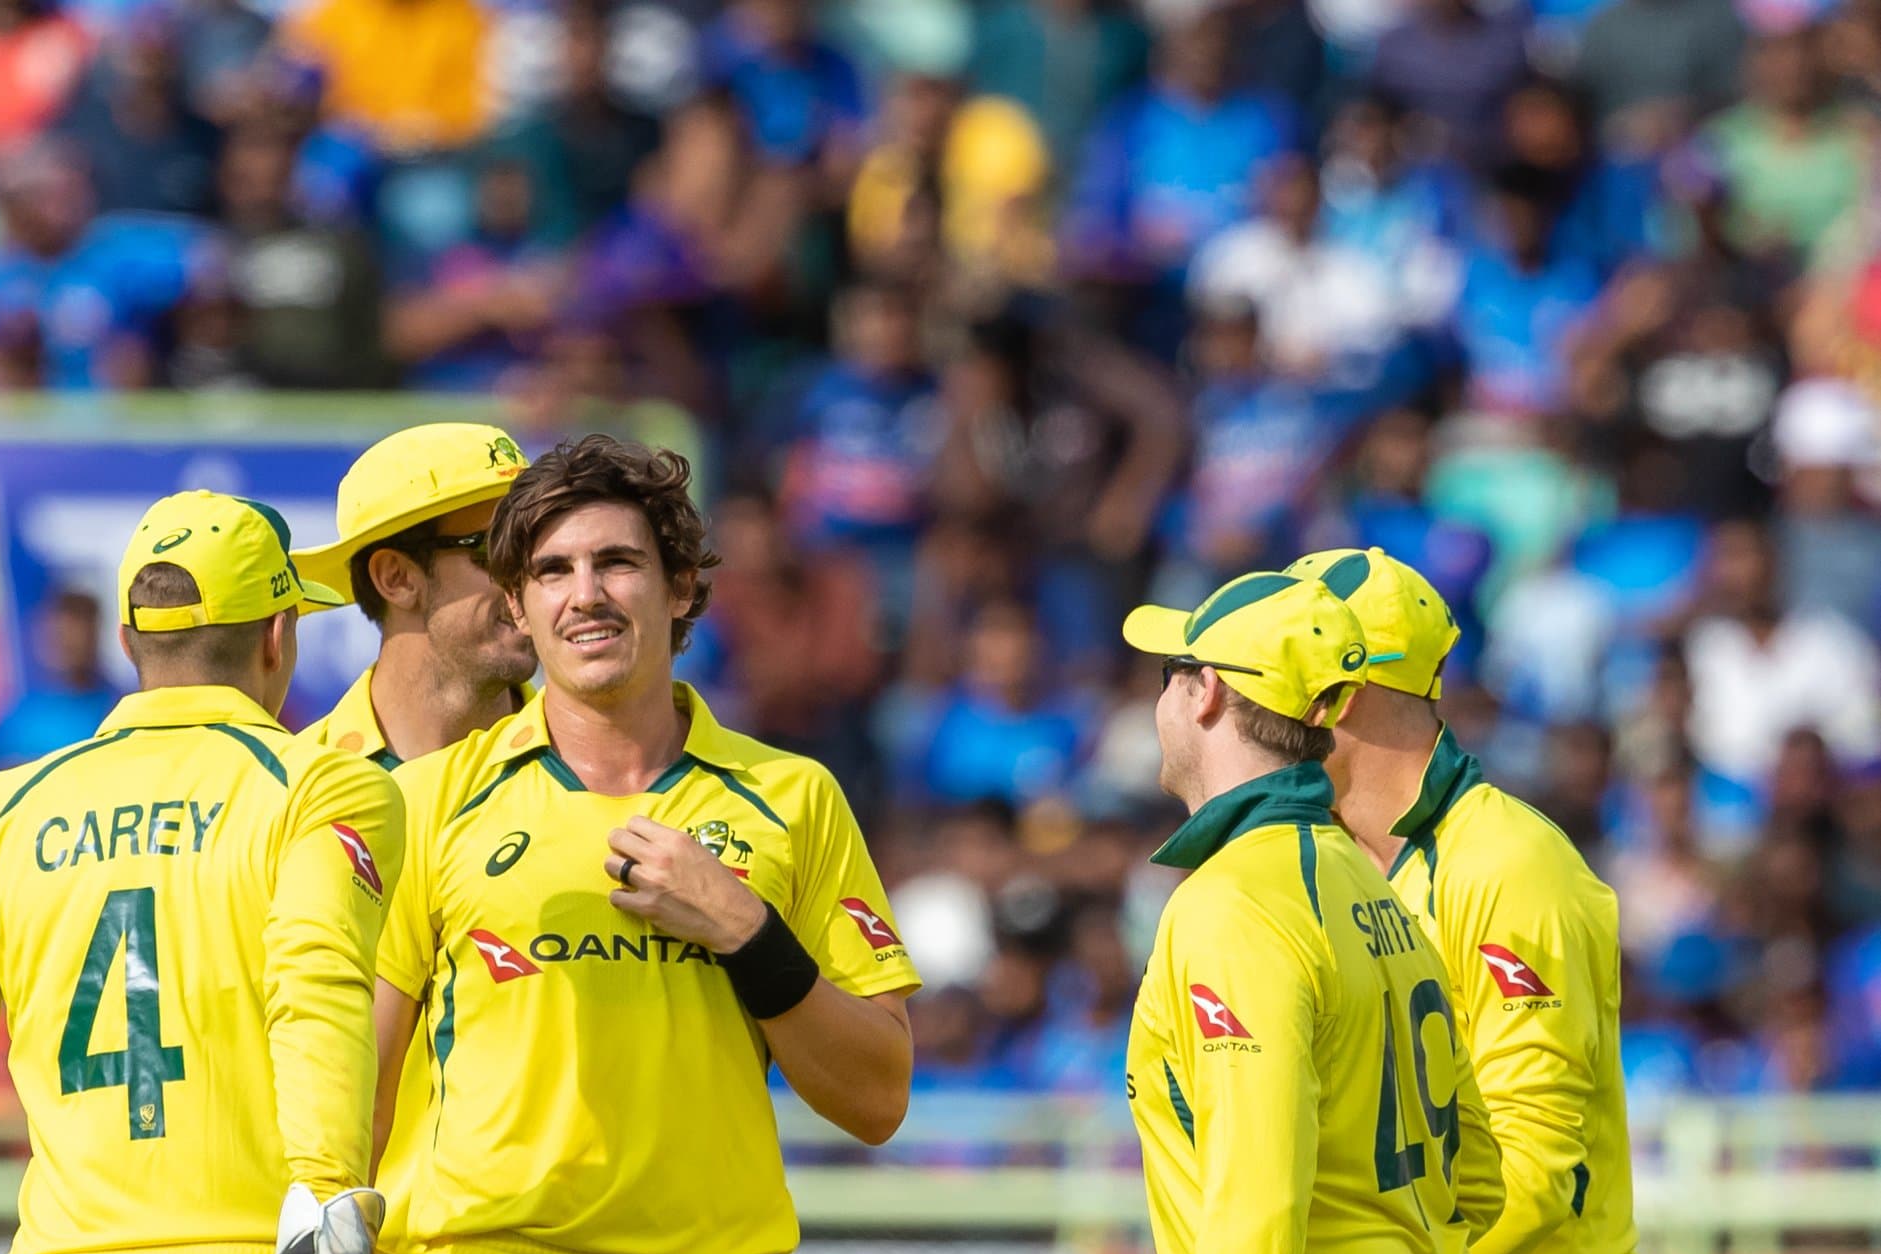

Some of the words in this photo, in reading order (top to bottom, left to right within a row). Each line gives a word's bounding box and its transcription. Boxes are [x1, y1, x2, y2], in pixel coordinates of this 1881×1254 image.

[270, 569, 291, 599] 223
[35, 800, 224, 872] CAREY
[351, 875, 383, 907] QANT
[529, 933, 721, 965] QANTA
[59, 885, 185, 1140] 4
[1203, 1041, 1262, 1054] QANTAS
